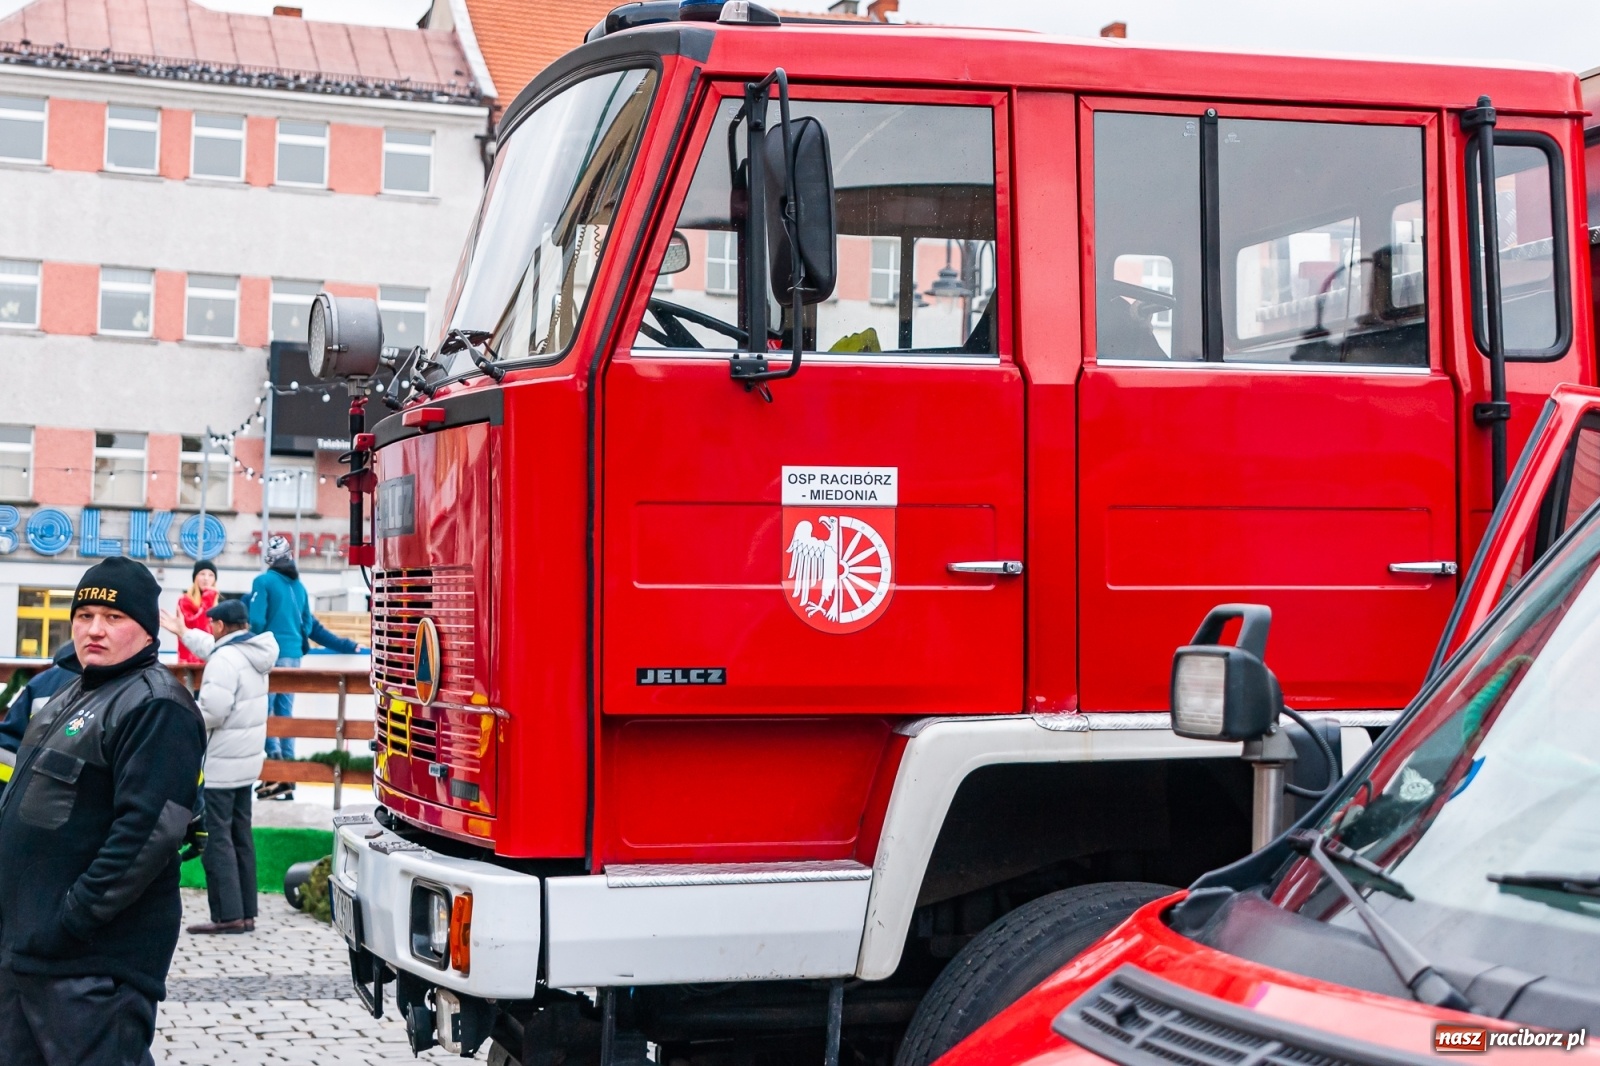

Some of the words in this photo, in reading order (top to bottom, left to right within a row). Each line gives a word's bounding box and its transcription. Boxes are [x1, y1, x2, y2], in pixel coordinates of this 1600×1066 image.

[787, 473, 816, 485] OSP
[820, 471, 892, 486] RACIBÓRZ
[810, 489, 878, 501] MIEDONIA
[641, 669, 722, 684] JELCZ
